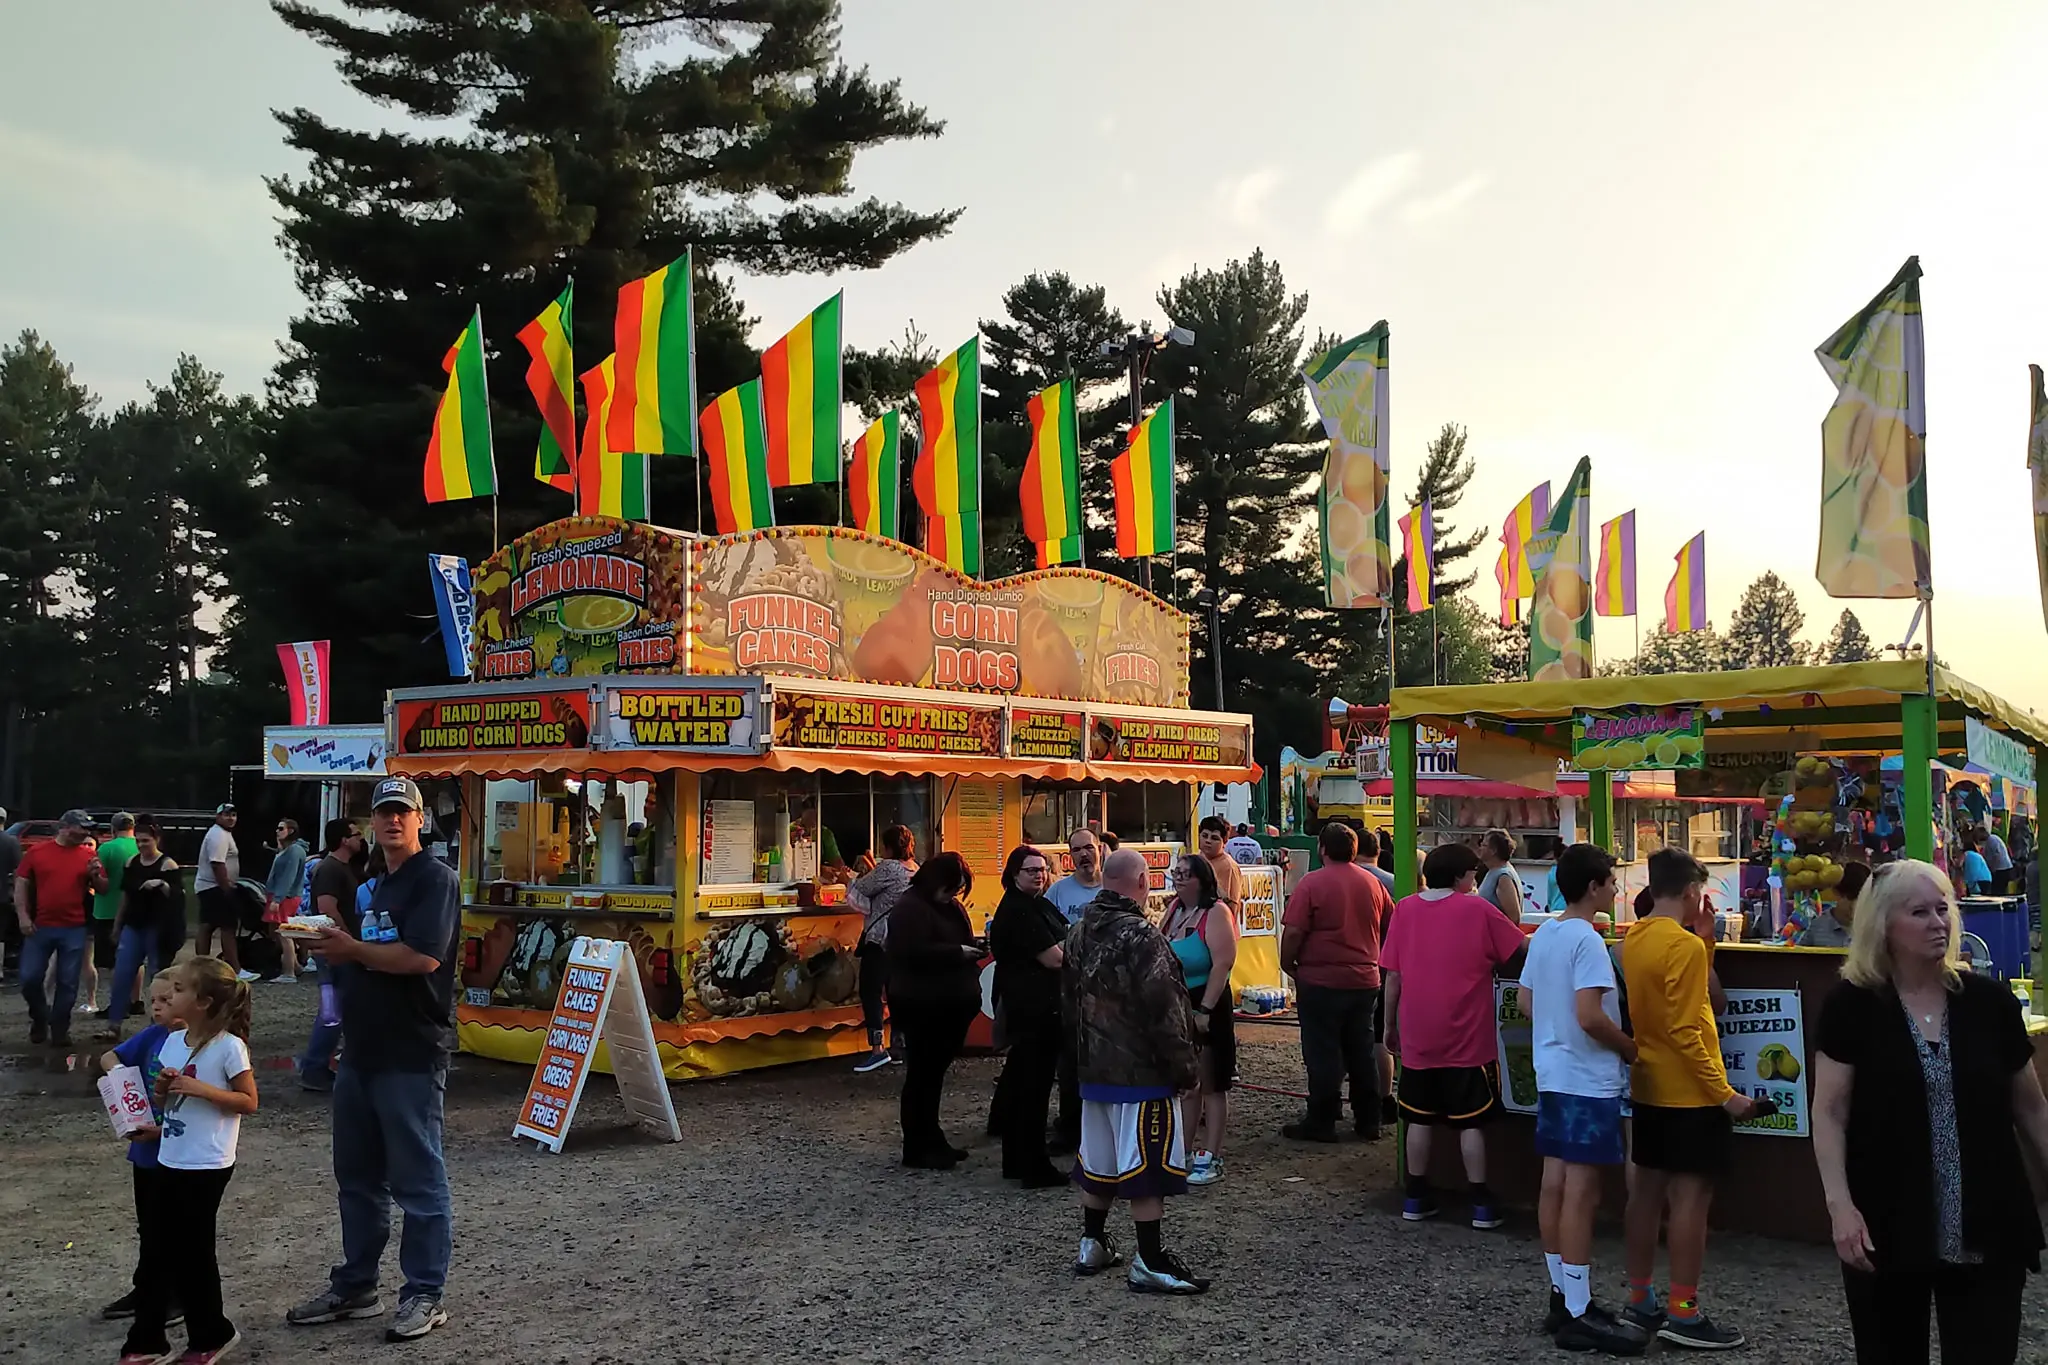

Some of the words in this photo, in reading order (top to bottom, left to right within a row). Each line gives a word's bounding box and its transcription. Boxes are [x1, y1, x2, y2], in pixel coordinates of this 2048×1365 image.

[531, 547, 562, 566] Fresh
[564, 530, 622, 557] Squeezed
[511, 554, 644, 616] LEMONADE
[927, 589, 954, 601] Hand
[957, 589, 991, 603] Dipped
[993, 590, 1023, 602] Jumbo
[727, 593, 839, 647] FUNNEL
[932, 600, 1018, 645] CORN
[505, 635, 534, 649] Cheese
[617, 629, 642, 642] Bacon
[644, 621, 676, 636] Cheese
[619, 636, 674, 667] FRIES
[737, 629, 831, 674] CAKES
[303, 652, 316, 686] ICE
[485, 650, 532, 677] FRIES
[934, 645, 1018, 689] DOGS
[1105, 652, 1160, 689] FRIES
[441, 704, 480, 723] HAND
[485, 701, 540, 721] DIPPED
[621, 695, 741, 717] BOTTLED
[814, 700, 875, 726] FRESH
[880, 705, 916, 729] CUT
[920, 708, 969, 731] FRIES
[635, 721, 726, 743] WATER
[1029, 714, 1061, 728] FRESH
[1121, 721, 1150, 738] DEEP
[1153, 723, 1184, 740] FRIED
[1187, 726, 1220, 743] OREOS
[420, 727, 469, 748] JUMBO
[473, 725, 516, 746] CORN
[521, 723, 566, 745] DOGS
[800, 727, 835, 744] CHILI
[838, 729, 887, 747] CHEESE
[897, 733, 936, 749] BACON
[939, 735, 981, 751] CHEESE
[1019, 727, 1071, 742] SQUEEZED
[289, 737, 318, 755] Yummy
[305, 740, 335, 758] Yummy
[1019, 742, 1072, 757] LEMONADE
[1121, 744, 1130, 757] &
[1134, 743, 1190, 760] ELEPHANT
[1193, 745, 1219, 761] EARS
[329, 754, 355, 770] Cream
[1418, 752, 1458, 772] TTON
[567, 968, 605, 991] FUNNEL
[564, 990, 598, 1012] CAKES
[1727, 997, 1781, 1016] RESH
[1717, 1018, 1796, 1037] QUEEZED
[548, 1028, 569, 1050] CORN
[568, 1031, 590, 1055] DOGS
[542, 1065, 573, 1089] OREOS
[1772, 1090, 1794, 1108] $5
[529, 1103, 560, 1128] FRIES
